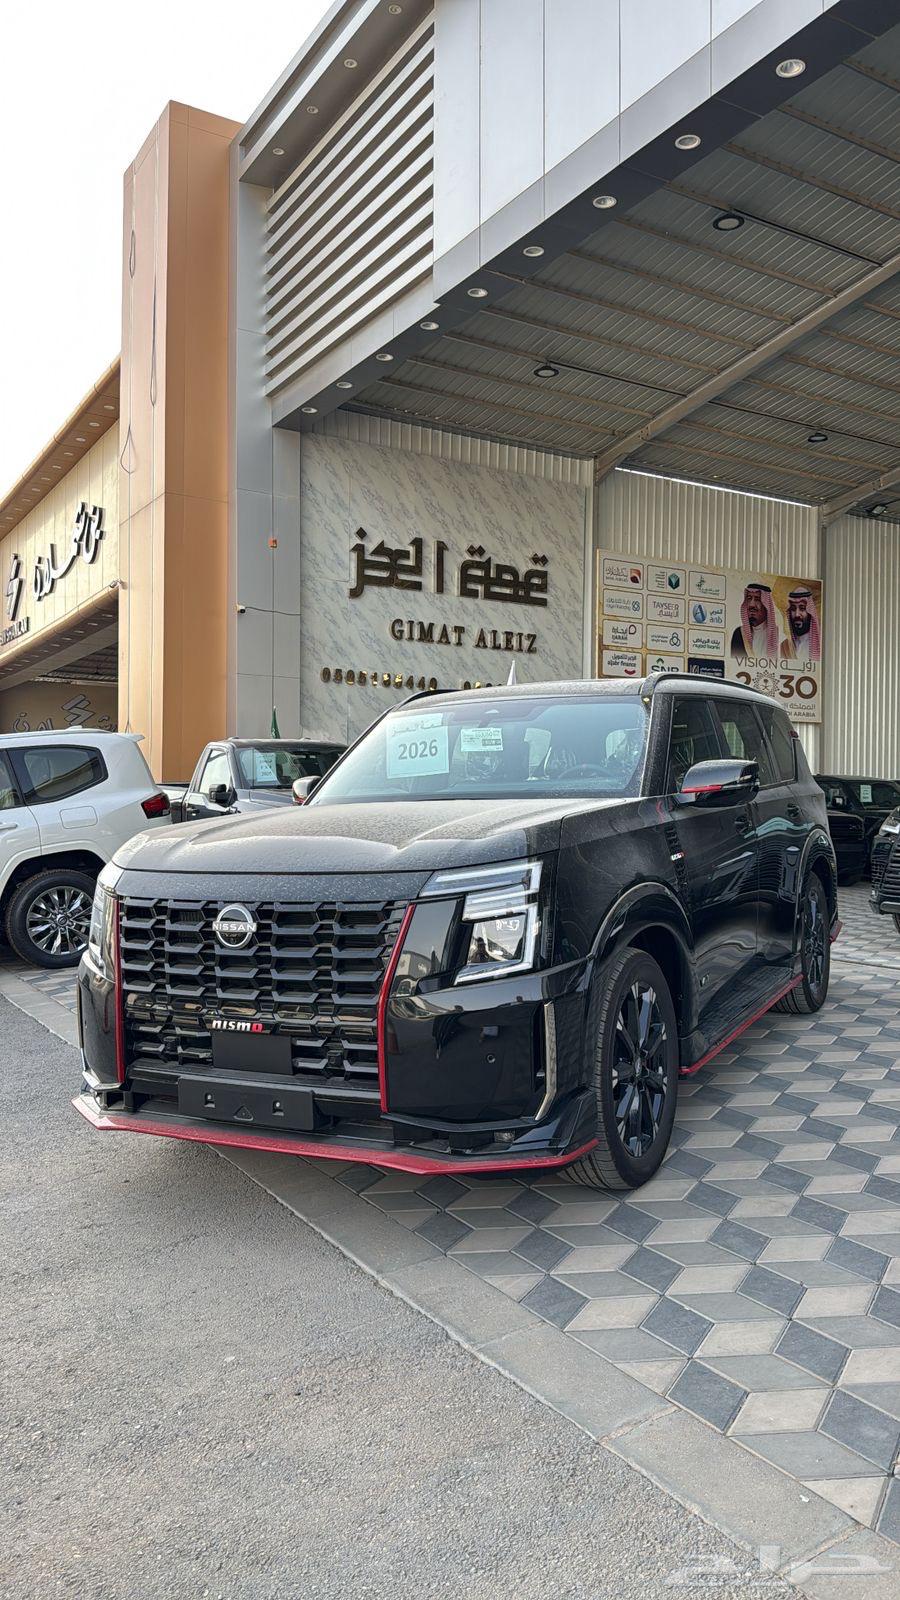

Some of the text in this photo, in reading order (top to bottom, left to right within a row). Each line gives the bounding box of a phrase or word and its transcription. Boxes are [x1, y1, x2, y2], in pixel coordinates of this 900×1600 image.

[653, 601, 679, 611] TAYSEER
[709, 616, 723, 624] anb
[390, 618, 538, 653] GIMAT ALEIZ
[736, 656, 778, 669] VISION
[398, 739, 438, 760] 2026
[212, 922, 256, 932] NISSAN
